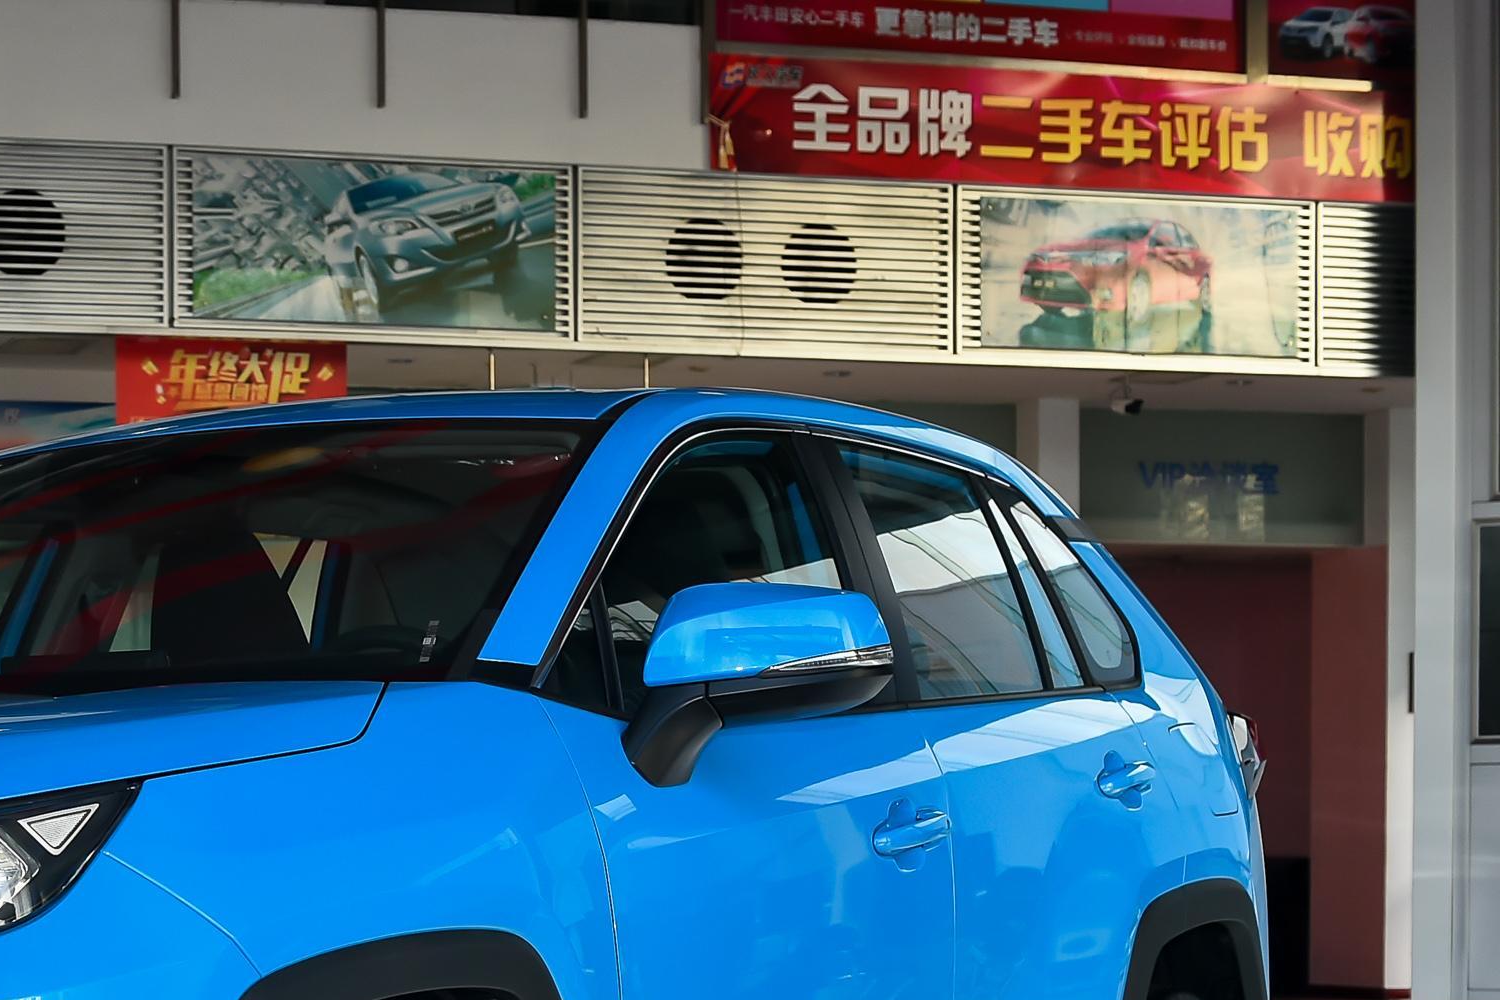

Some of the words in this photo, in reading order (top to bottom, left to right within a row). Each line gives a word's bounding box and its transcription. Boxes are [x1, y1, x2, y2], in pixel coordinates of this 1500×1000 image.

[875, 7, 1059, 47] 更靠谱的二手车
[792, 83, 1268, 172] 全品牌二手车评估
[1304, 110, 1412, 178] 收购
[162, 350, 311, 404] 年终大促
